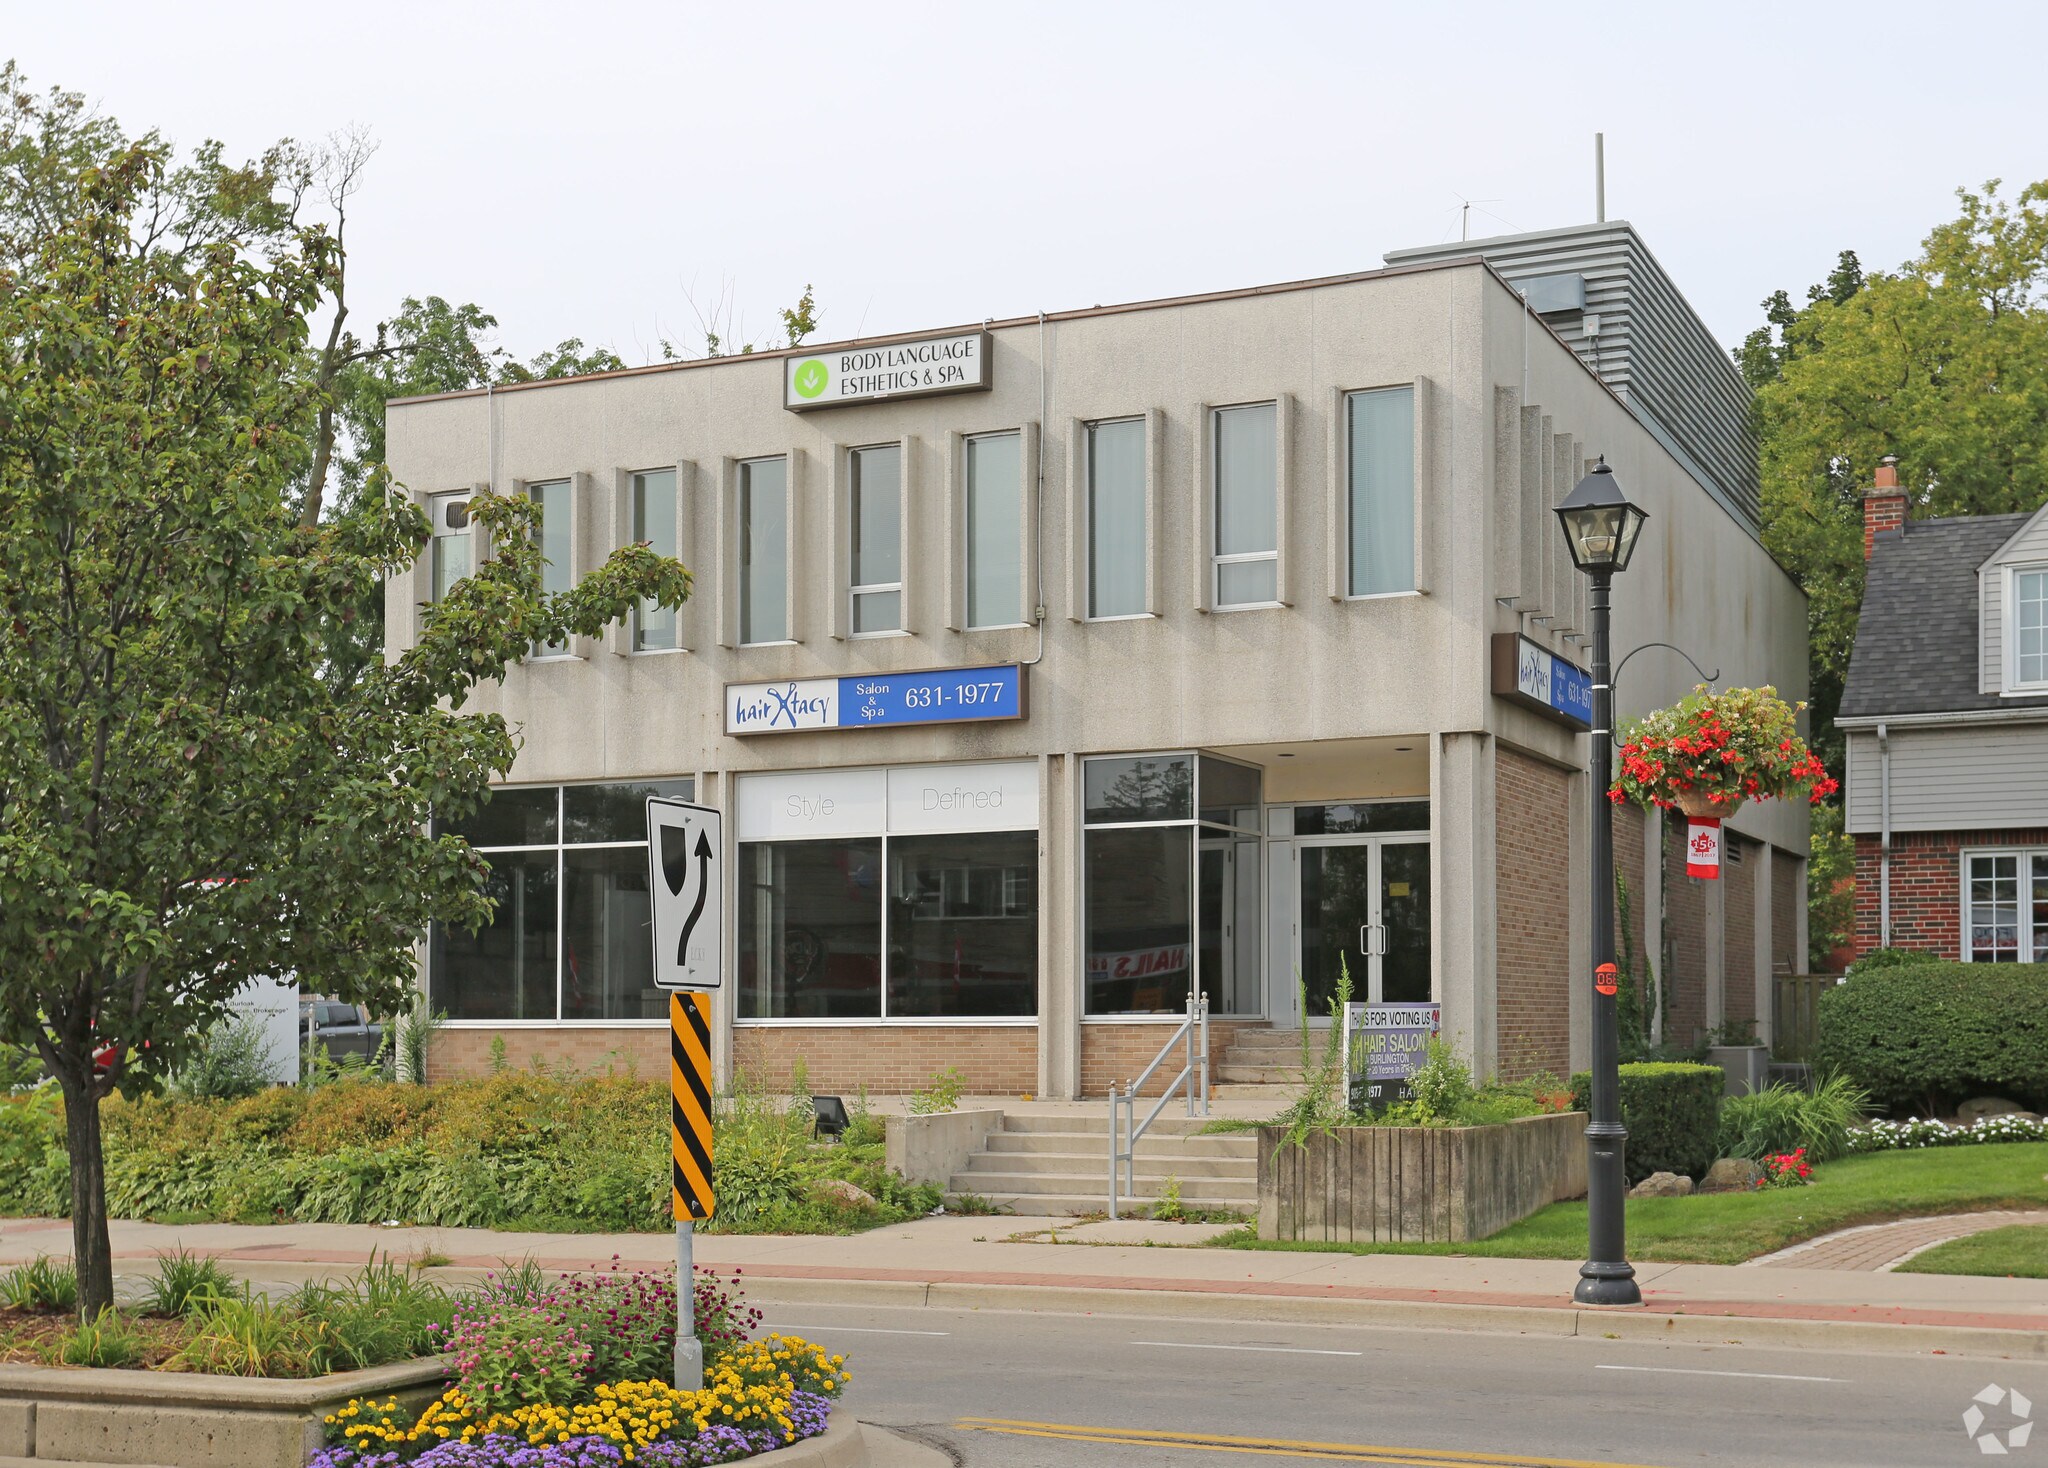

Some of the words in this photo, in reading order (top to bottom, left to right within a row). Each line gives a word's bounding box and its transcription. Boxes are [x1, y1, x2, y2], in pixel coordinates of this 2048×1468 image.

[841, 370, 918, 395] ESTHETICS
[923, 368, 933, 385] &
[938, 365, 964, 384] SPA
[856, 683, 889, 696] Salon
[905, 682, 1004, 708] 631-1977
[1568, 681, 1592, 709] 631-197
[868, 696, 877, 705] &
[861, 706, 885, 721] Spa
[786, 795, 835, 821] Style
[923, 786, 1003, 811] Defined
[1693, 840, 1714, 850] 150
[1371, 1011, 1387, 1026] FOR
[1389, 1011, 1420, 1025] VOTING
[1422, 1011, 1431, 1025] US
[1363, 1034, 1386, 1053] HAIR
[1389, 1033, 1425, 1053] SALON
[1370, 1053, 1410, 1064] BURLINGTON
[1379, 1064, 1395, 1074] Years
